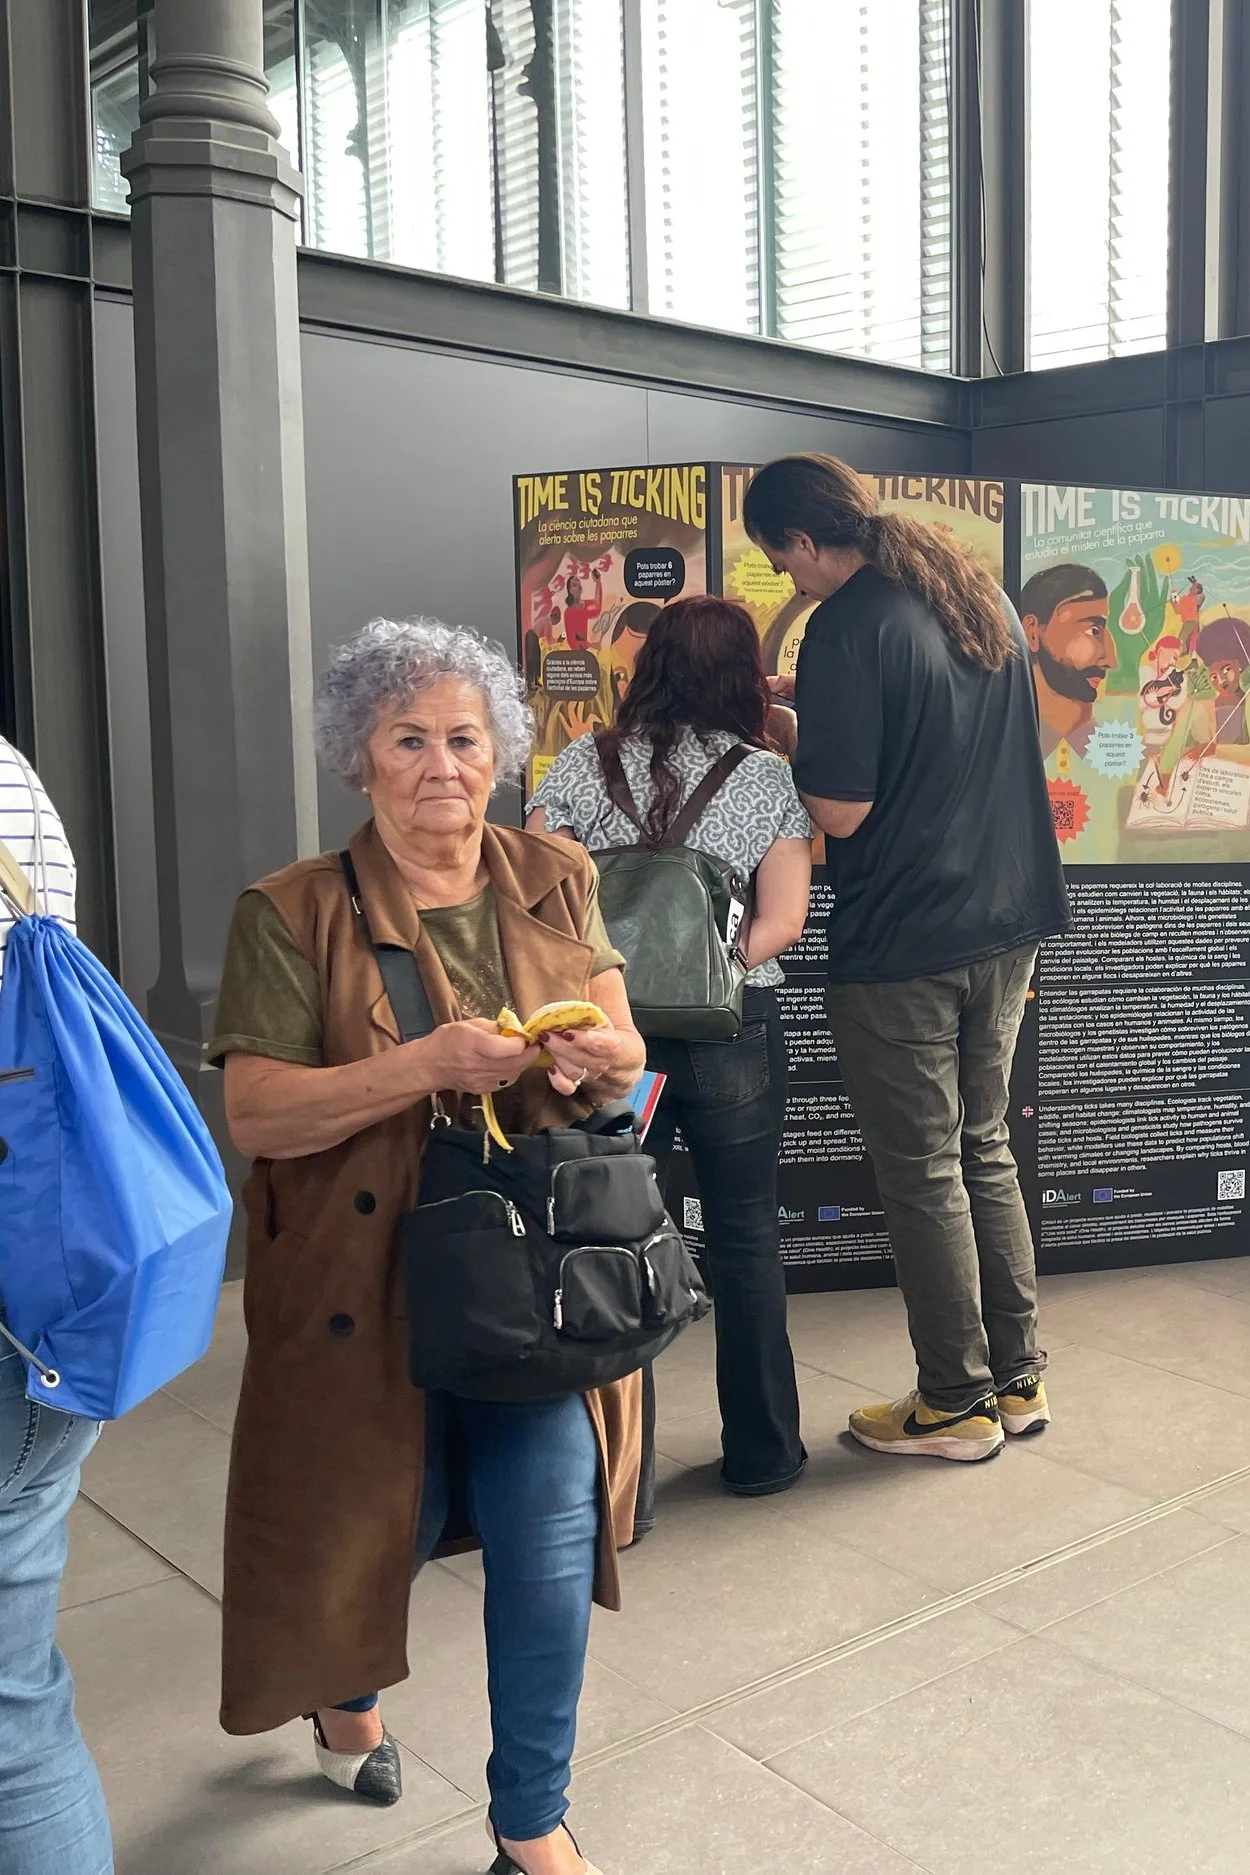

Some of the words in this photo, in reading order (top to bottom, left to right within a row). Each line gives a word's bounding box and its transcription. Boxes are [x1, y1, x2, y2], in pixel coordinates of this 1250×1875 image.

[518, 475, 569, 530] TIME
[580, 473, 602, 515] IS
[610, 466, 706, 529] TICKING
[723, 467, 751, 522] TI
[873, 474, 1004, 524] TICKING
[1022, 485, 1096, 536] TIME
[1112, 490, 1141, 521] IS
[538, 520, 547, 532] La
[550, 518, 576, 531] ciència
[579, 514, 619, 528] ciutadana
[622, 515, 638, 528] que
[540, 533, 561, 545] alerta
[563, 532, 585, 543] sobre
[587, 529, 598, 541] les
[601, 529, 638, 544] paparres
[1034, 537, 1044, 547] La
[1047, 530, 1092, 545] comunitat
[1094, 524, 1132, 538] científica
[1136, 521, 1152, 531] que
[1025, 546, 1058, 560] estudia
[1061, 544, 1069, 554] el
[1102, 536, 1114, 547] de
[1118, 533, 1125, 544] la
[1128, 529, 1164, 546] paparra
[637, 562, 649, 570] Pots
[650, 562, 667, 570] trobar
[638, 571, 662, 579] paparres
[634, 578, 653, 587] aquest
[654, 579, 676, 587] pòster?
[792, 1096, 818, 1104] through
[1039, 1104, 1083, 1112] Understanding
[1134, 1099, 1166, 1107] disciplines.
[1122, 1106, 1161, 1115] climatologists
[783, 1139, 796, 1147] pick
[799, 1139, 807, 1147] up
[823, 1137, 847, 1146] spread.
[827, 1145, 860, 1153] conditions
[779, 1157, 796, 1165] push
[798, 1155, 814, 1163] them
[830, 1154, 863, 1162] dormancy.
[1042, 1189, 1081, 1203] iDAlert
[778, 1206, 805, 1219] Alert
[1016, 1375, 1037, 1389] NIKE
[985, 1395, 998, 1408] NIK
